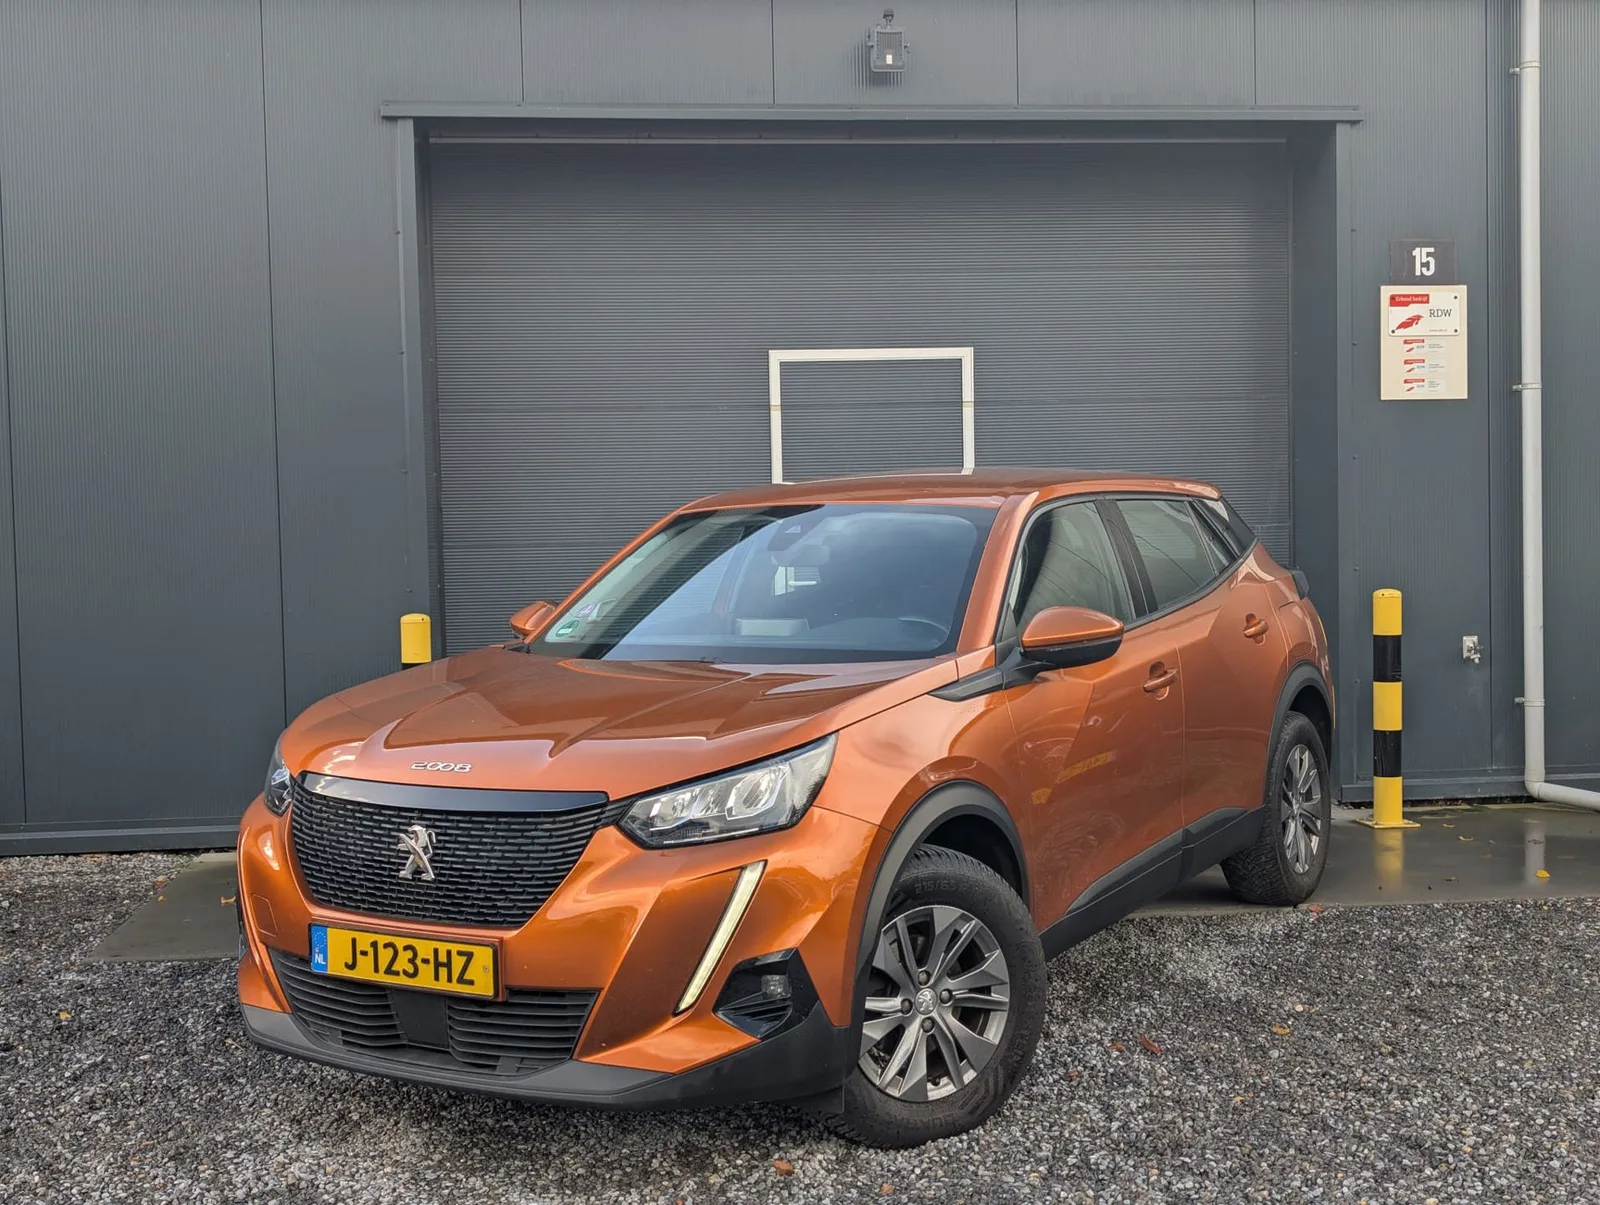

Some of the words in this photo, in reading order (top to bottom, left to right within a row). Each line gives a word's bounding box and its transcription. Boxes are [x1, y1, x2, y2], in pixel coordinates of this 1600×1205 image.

[1412, 247, 1435, 276] 15
[1429, 309, 1452, 318] RDW
[410, 761, 472, 773] 2008
[314, 953, 326, 965] NL
[344, 937, 475, 986] J-123-HZ
